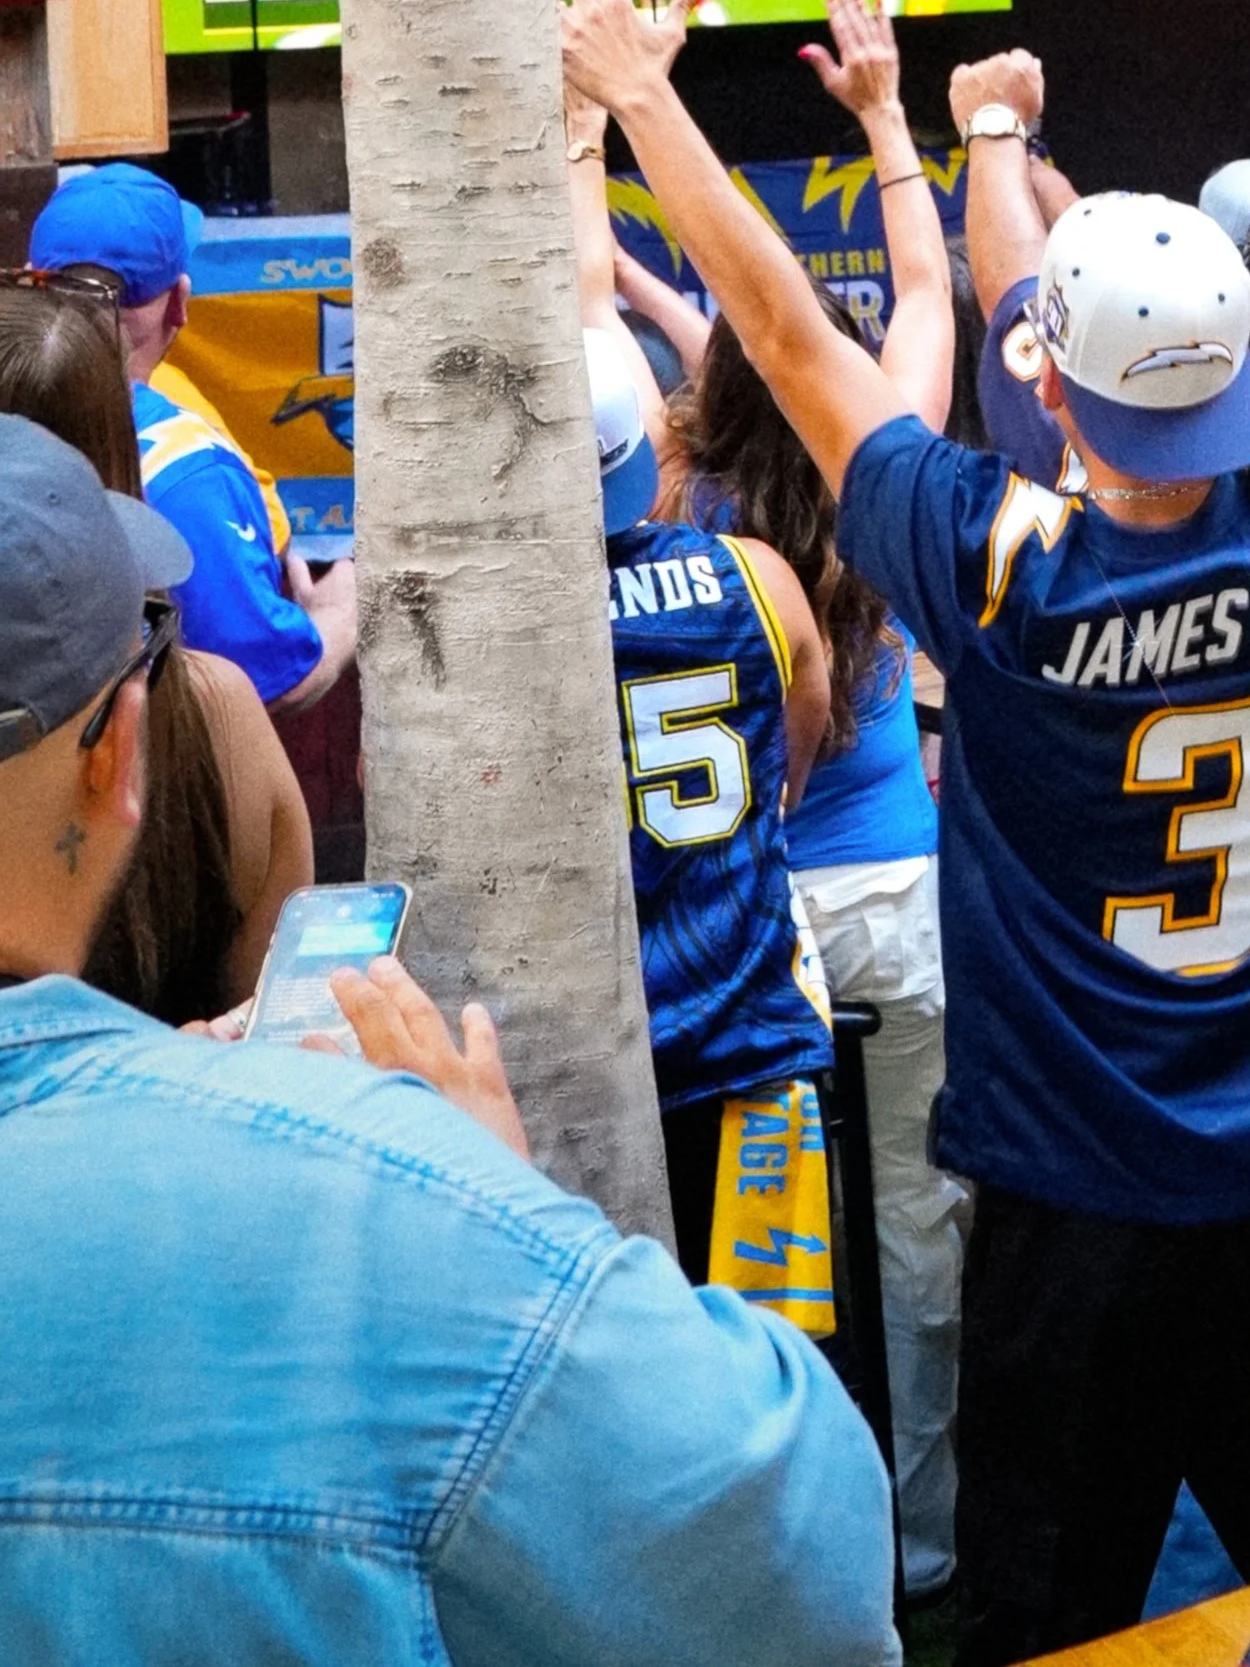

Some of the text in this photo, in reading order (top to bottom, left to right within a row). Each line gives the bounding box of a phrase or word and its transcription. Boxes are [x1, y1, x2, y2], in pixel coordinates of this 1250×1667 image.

[796, 247, 887, 278] HERN
[610, 555, 723, 621] NDS
[1042, 587, 1250, 689] JAMES
